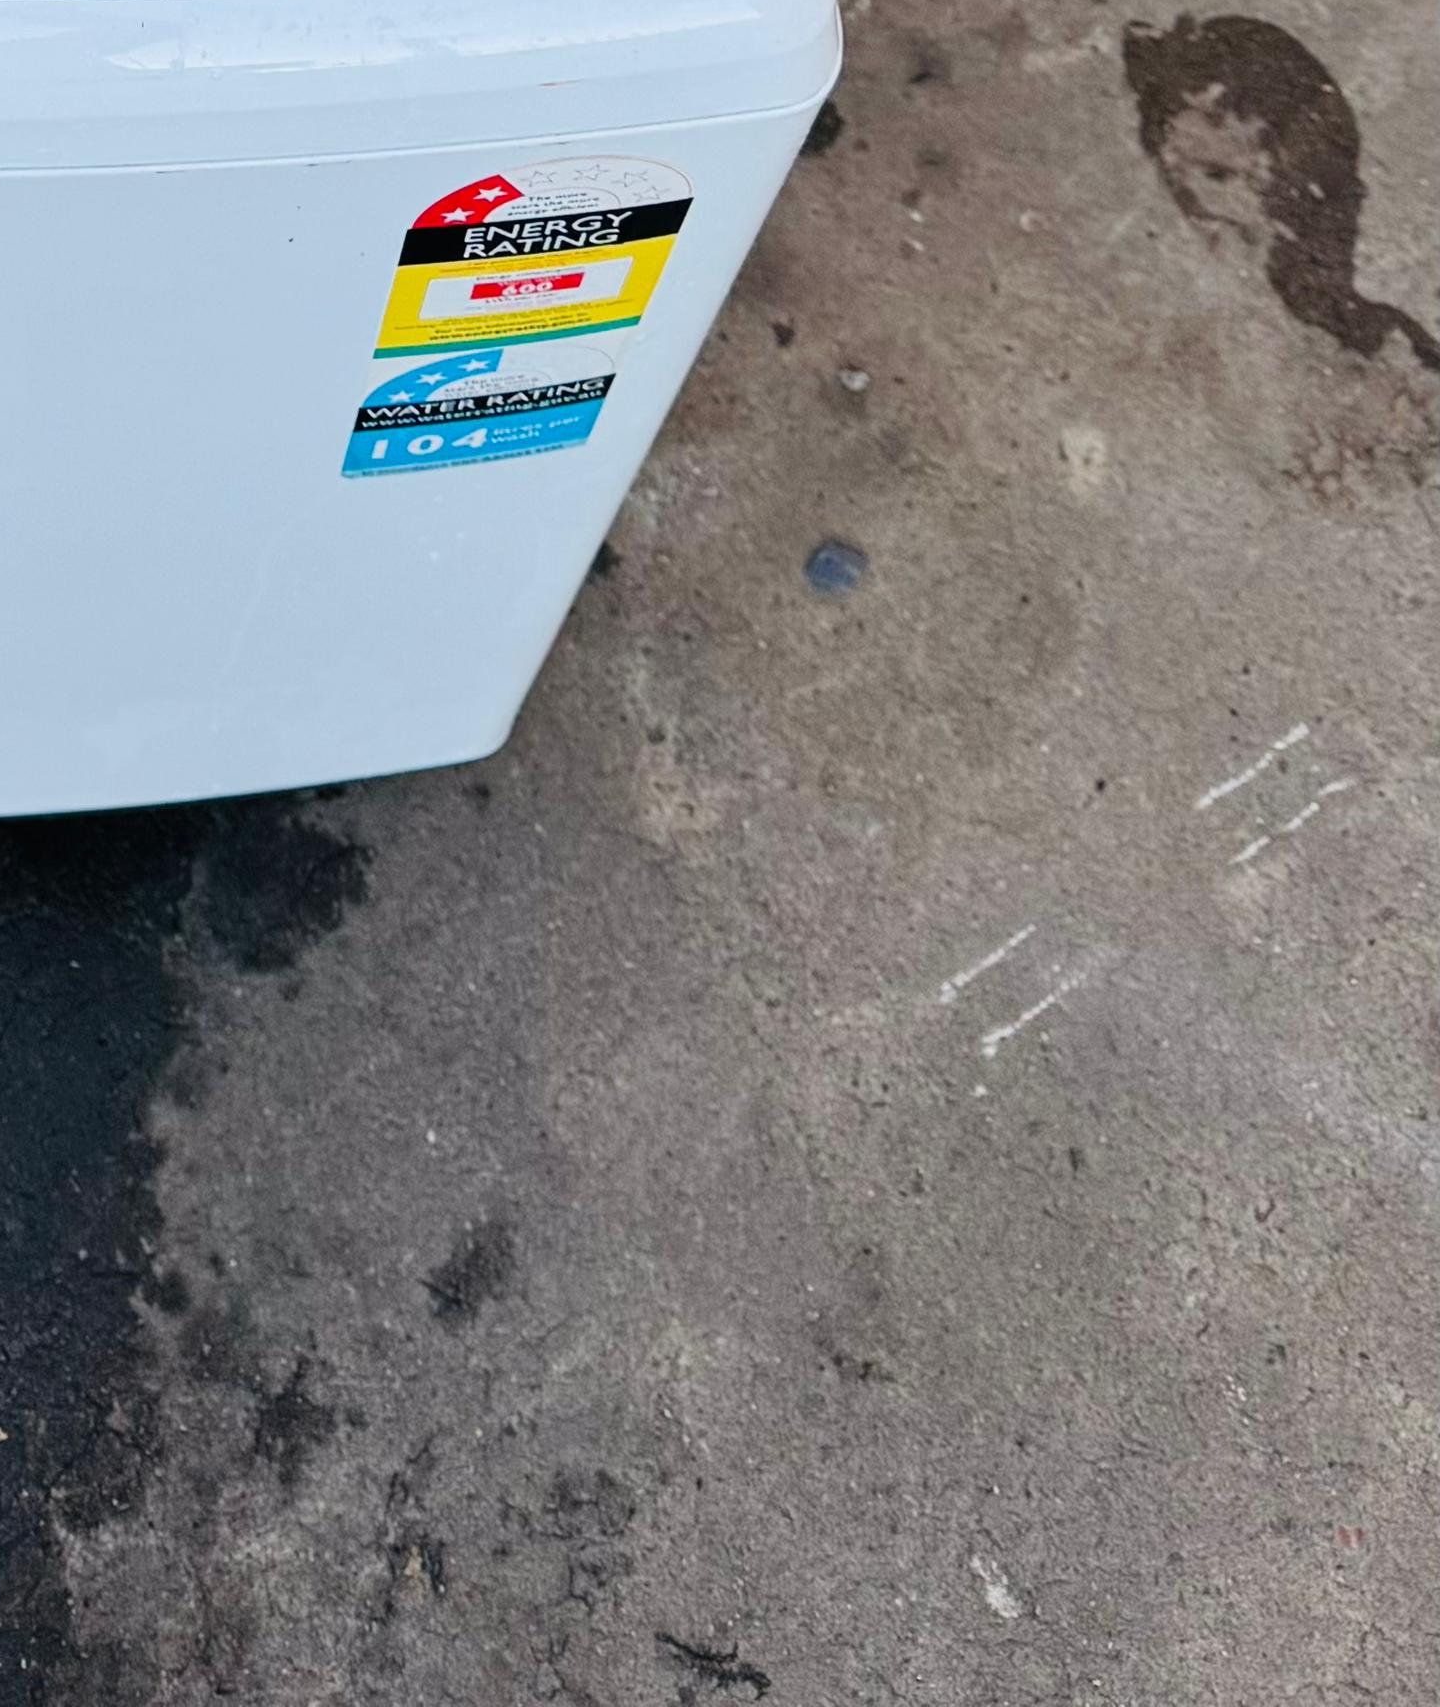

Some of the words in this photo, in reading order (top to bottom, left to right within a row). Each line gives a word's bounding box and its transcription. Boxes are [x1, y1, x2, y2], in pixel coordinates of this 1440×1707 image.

[463, 210, 634, 244] ENERGY
[462, 228, 620, 259] RATING
[500, 280, 555, 298] 600
[364, 398, 477, 419] WATER
[485, 376, 606, 408] RATING
